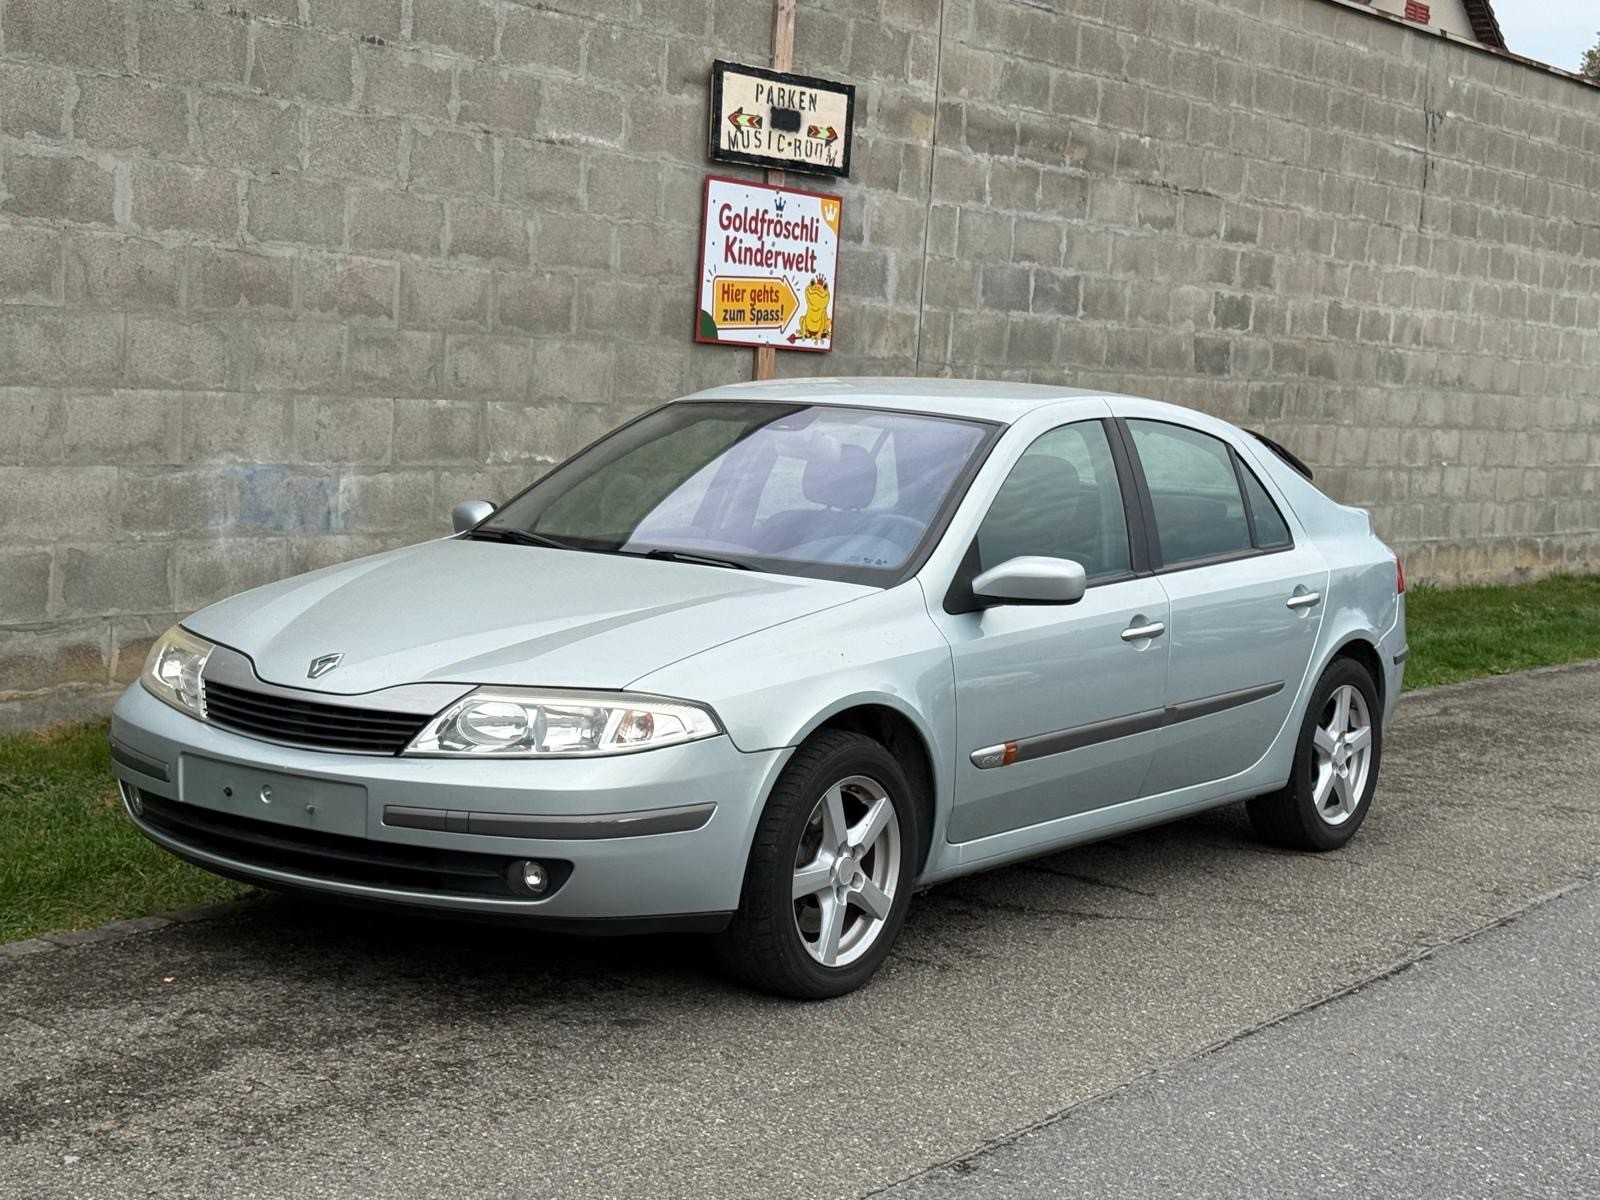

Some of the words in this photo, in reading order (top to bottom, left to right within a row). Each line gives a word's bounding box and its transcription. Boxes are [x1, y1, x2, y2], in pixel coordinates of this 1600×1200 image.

[755, 83, 817, 112] PARKEN
[719, 203, 819, 243] Goldfröschli
[724, 235, 817, 273] Kinderwelt
[721, 283, 746, 303] Hier
[750, 285, 779, 307] gehts
[722, 309, 745, 322] zum
[749, 304, 784, 325] Spass!
